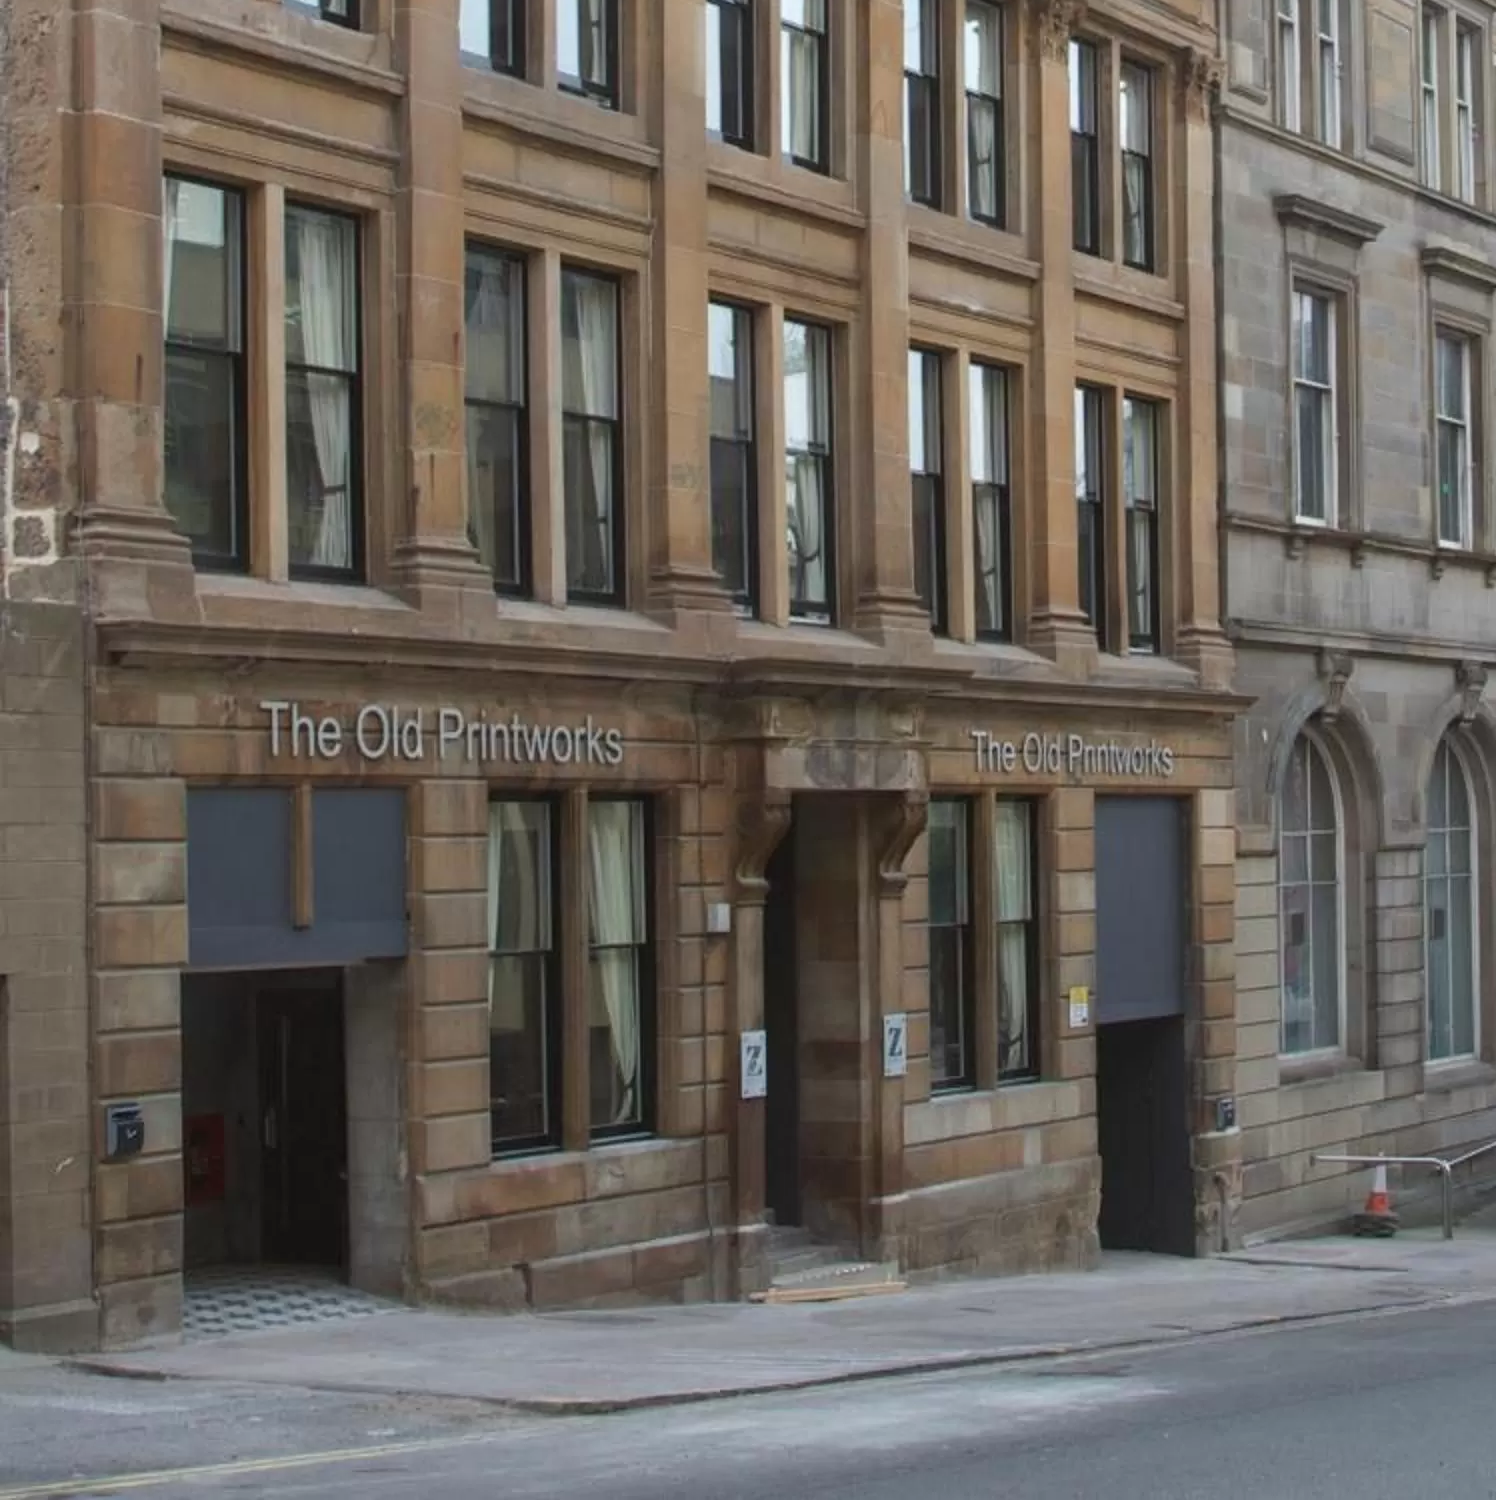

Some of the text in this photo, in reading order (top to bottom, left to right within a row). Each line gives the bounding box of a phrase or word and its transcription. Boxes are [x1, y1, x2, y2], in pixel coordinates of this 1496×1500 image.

[260, 701, 624, 766] The Old Printworks
[971, 729, 1174, 776] The Old Printworks
